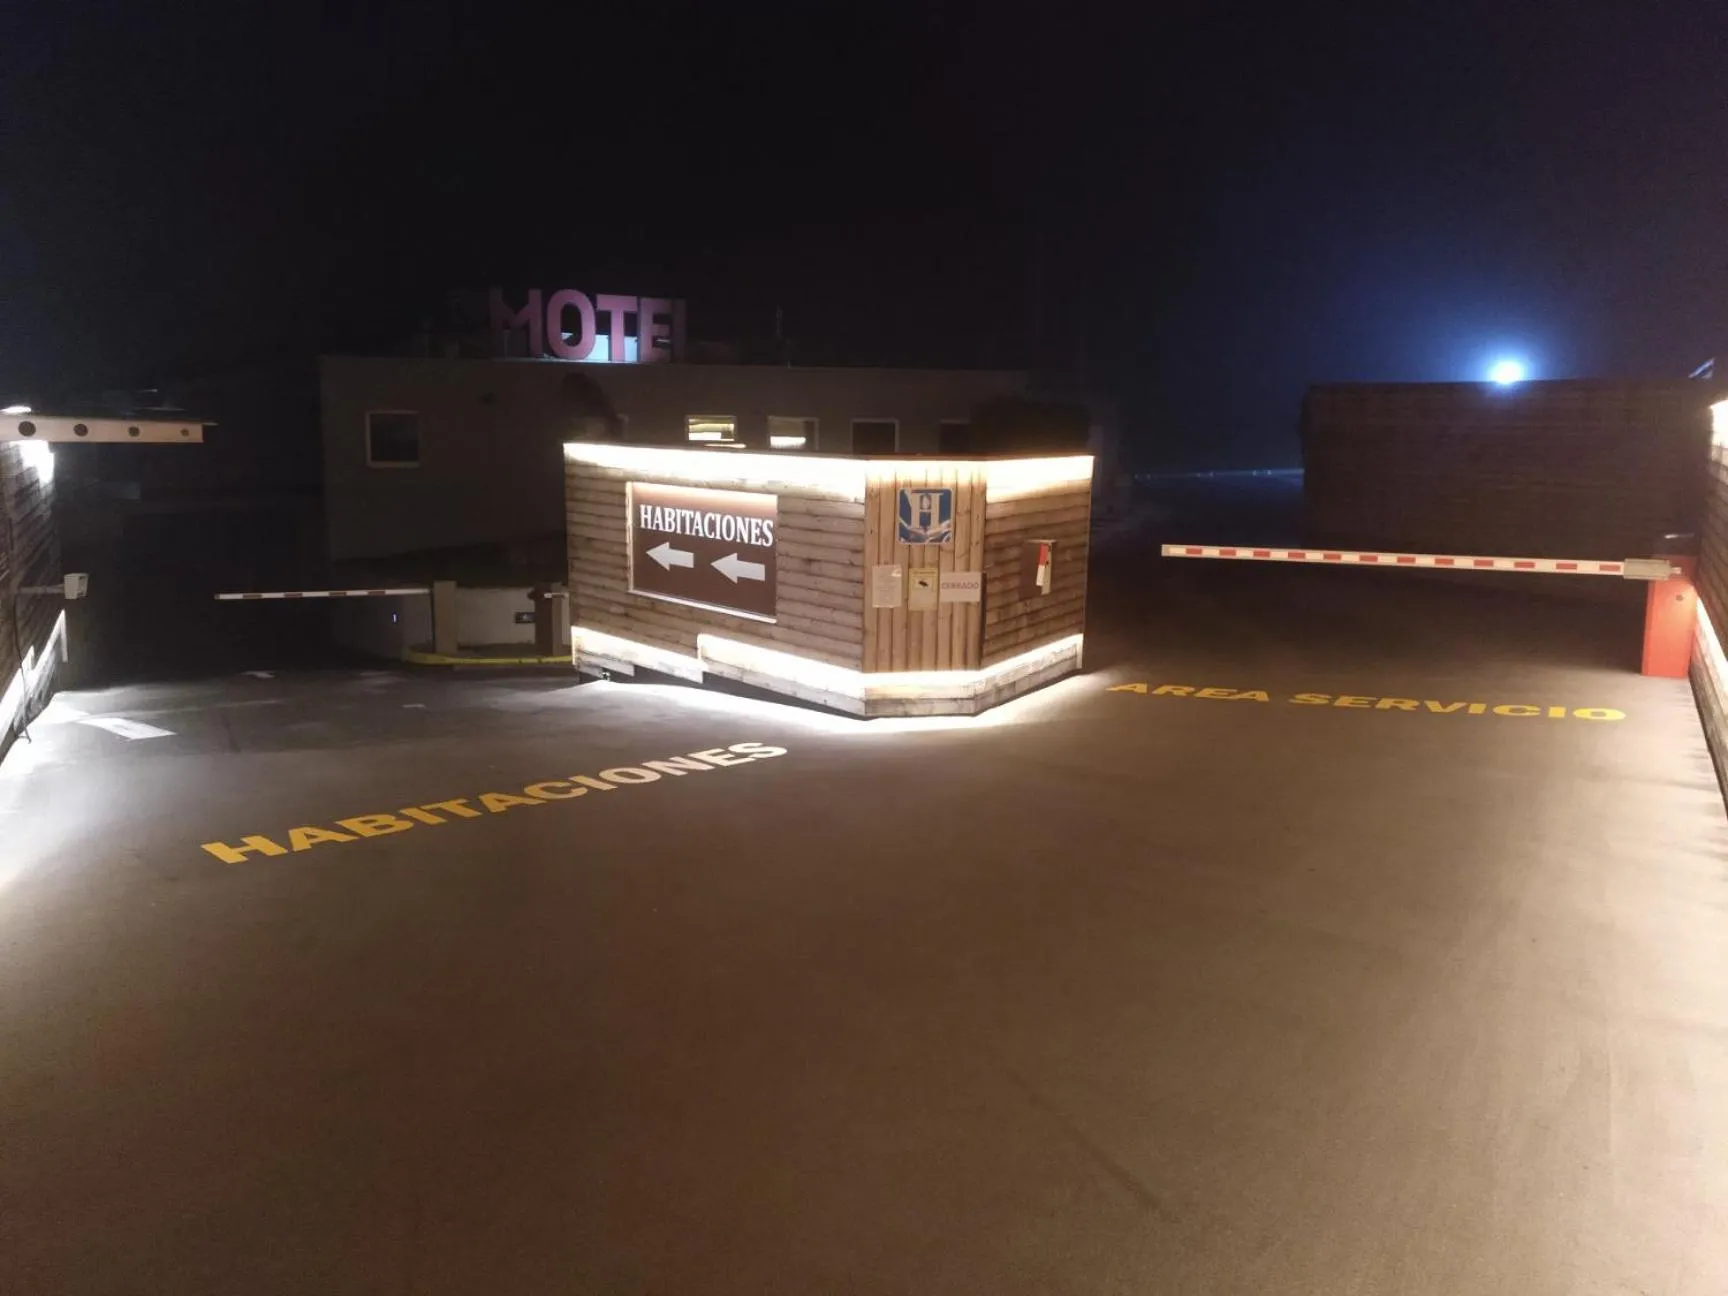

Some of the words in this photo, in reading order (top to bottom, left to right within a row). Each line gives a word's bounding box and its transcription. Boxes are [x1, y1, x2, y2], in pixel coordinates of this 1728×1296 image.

[639, 504, 774, 547] HABITACIONES
[1106, 683, 1269, 702] AREA
[1288, 692, 1627, 721] SERVICIO
[201, 742, 788, 864] HABITACIONES
